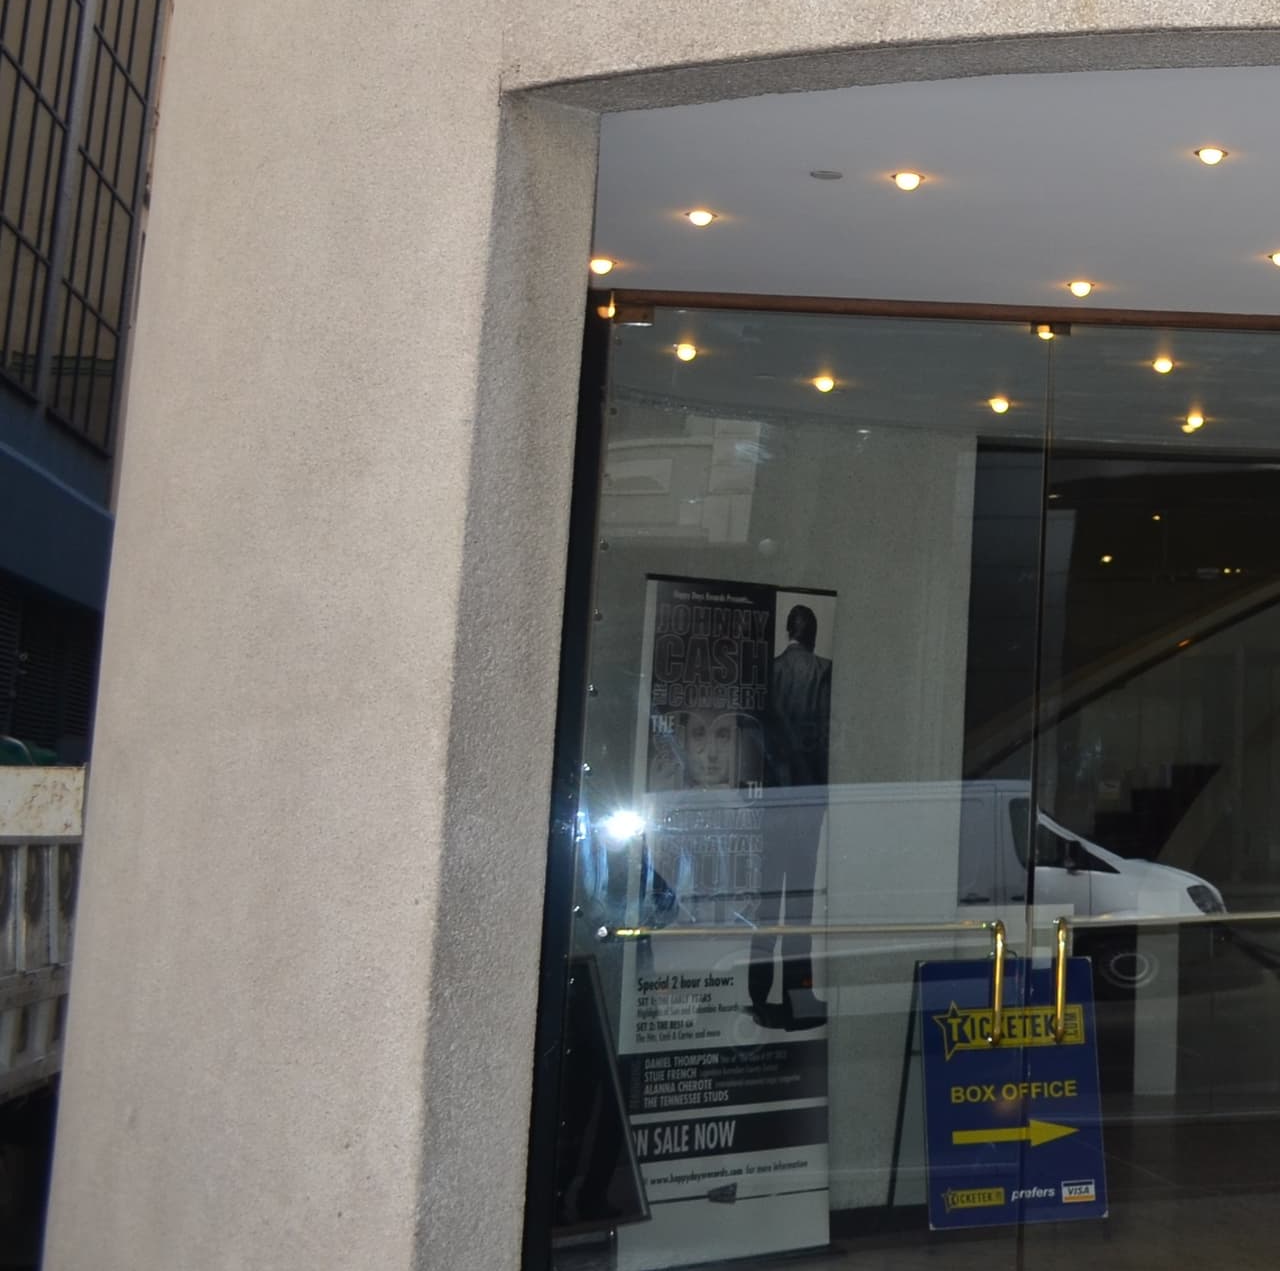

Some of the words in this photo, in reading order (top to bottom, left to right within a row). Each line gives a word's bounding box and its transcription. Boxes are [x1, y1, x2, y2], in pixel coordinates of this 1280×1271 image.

[656, 602, 770, 640] JOHNNY
[655, 633, 769, 686] CASH
[667, 683, 768, 710] CONCERT
[651, 714, 676, 736] THE
[637, 975, 670, 995] Special
[671, 975, 679, 989] 2
[680, 973, 701, 988] hour
[704, 972, 735, 987] show:
[644, 1057, 672, 1070] DANIEL
[674, 1053, 720, 1068] THOMPSON
[667, 1067, 698, 1080] FRENCH
[659, 1093, 701, 1107] TENNESSEE
[703, 1089, 729, 1103] STUDS
[950, 1084, 997, 1104] BOX
[1002, 1079, 1079, 1101] OFFICE
[653, 1124, 689, 1155] SALE
[694, 1119, 737, 1151] NOW
[1010, 1186, 1056, 1203] prefers
[1067, 1186, 1090, 1196] VISA
